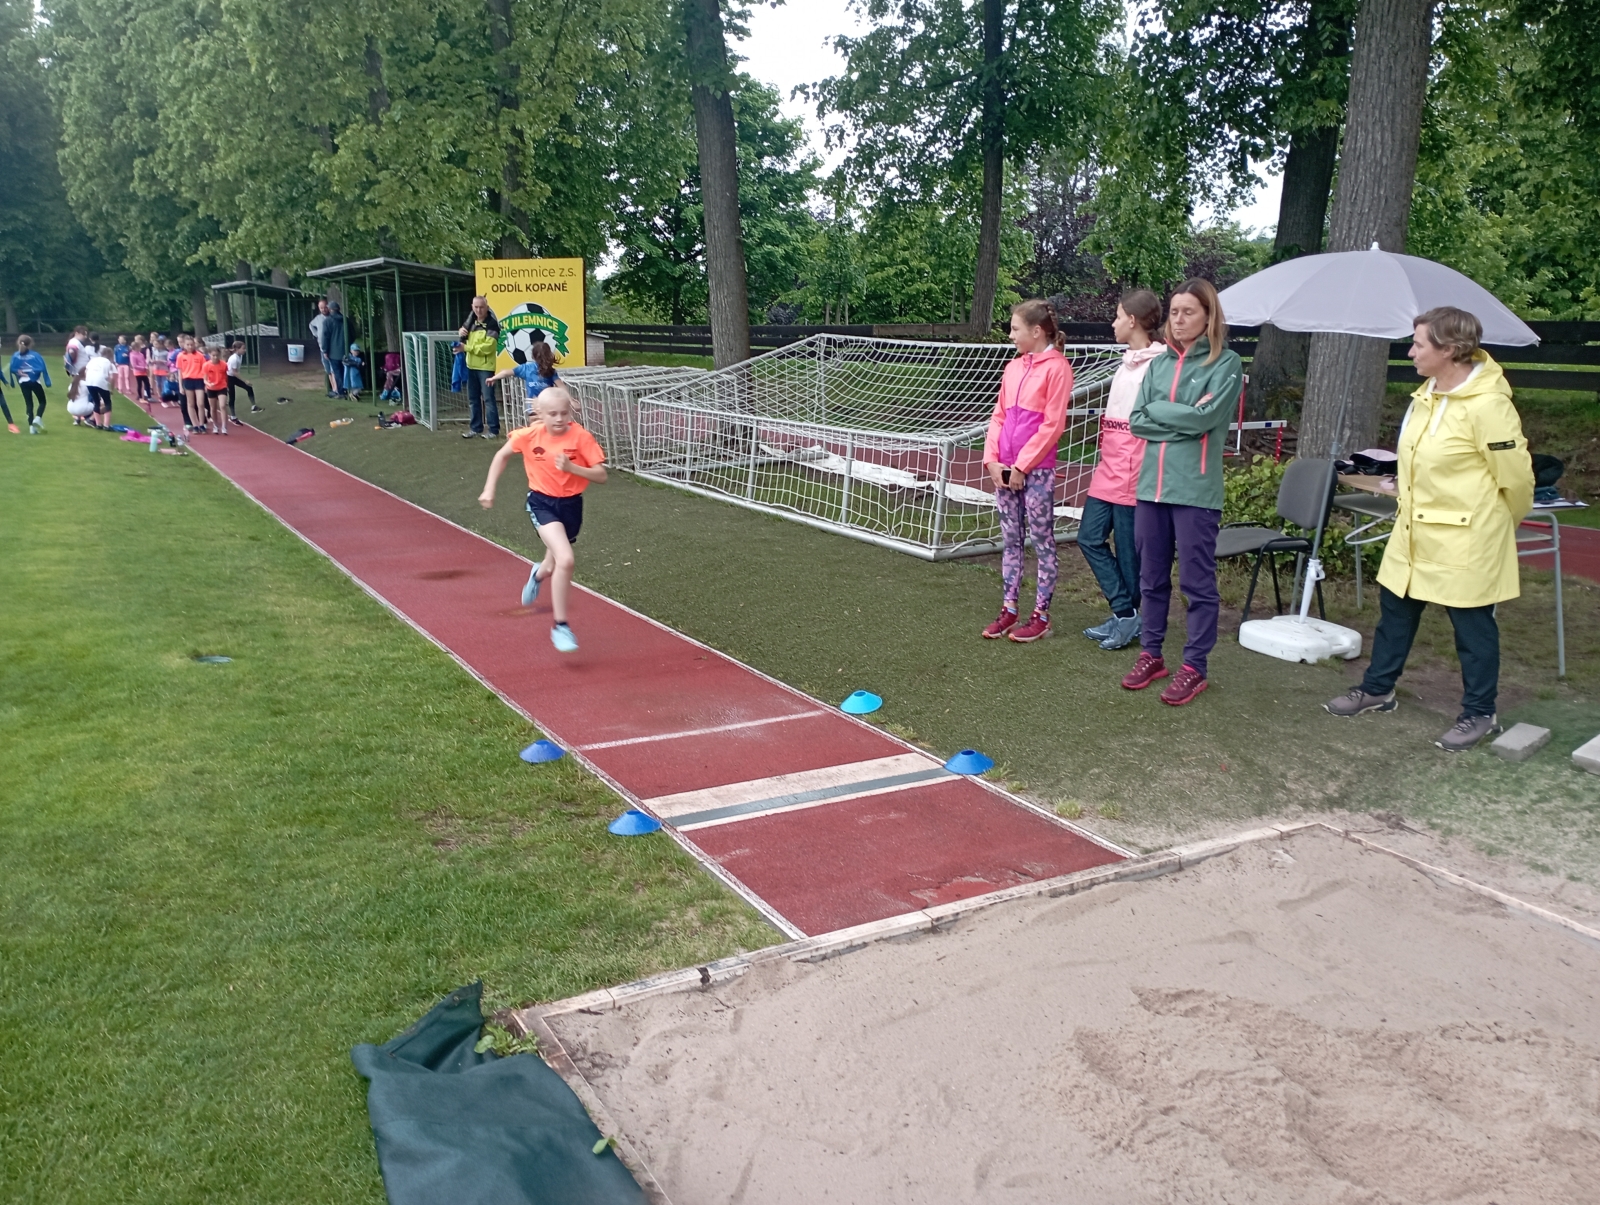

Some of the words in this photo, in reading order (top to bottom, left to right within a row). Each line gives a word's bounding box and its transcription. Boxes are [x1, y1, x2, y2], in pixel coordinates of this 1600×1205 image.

[482, 267, 495, 278] TJ
[498, 266, 556, 279] Jilemnice
[559, 267, 577, 278] z.s.
[491, 282, 523, 293] ODDÍL
[525, 281, 568, 293] KOPANÉ
[511, 315, 559, 332] JILEMNICE
